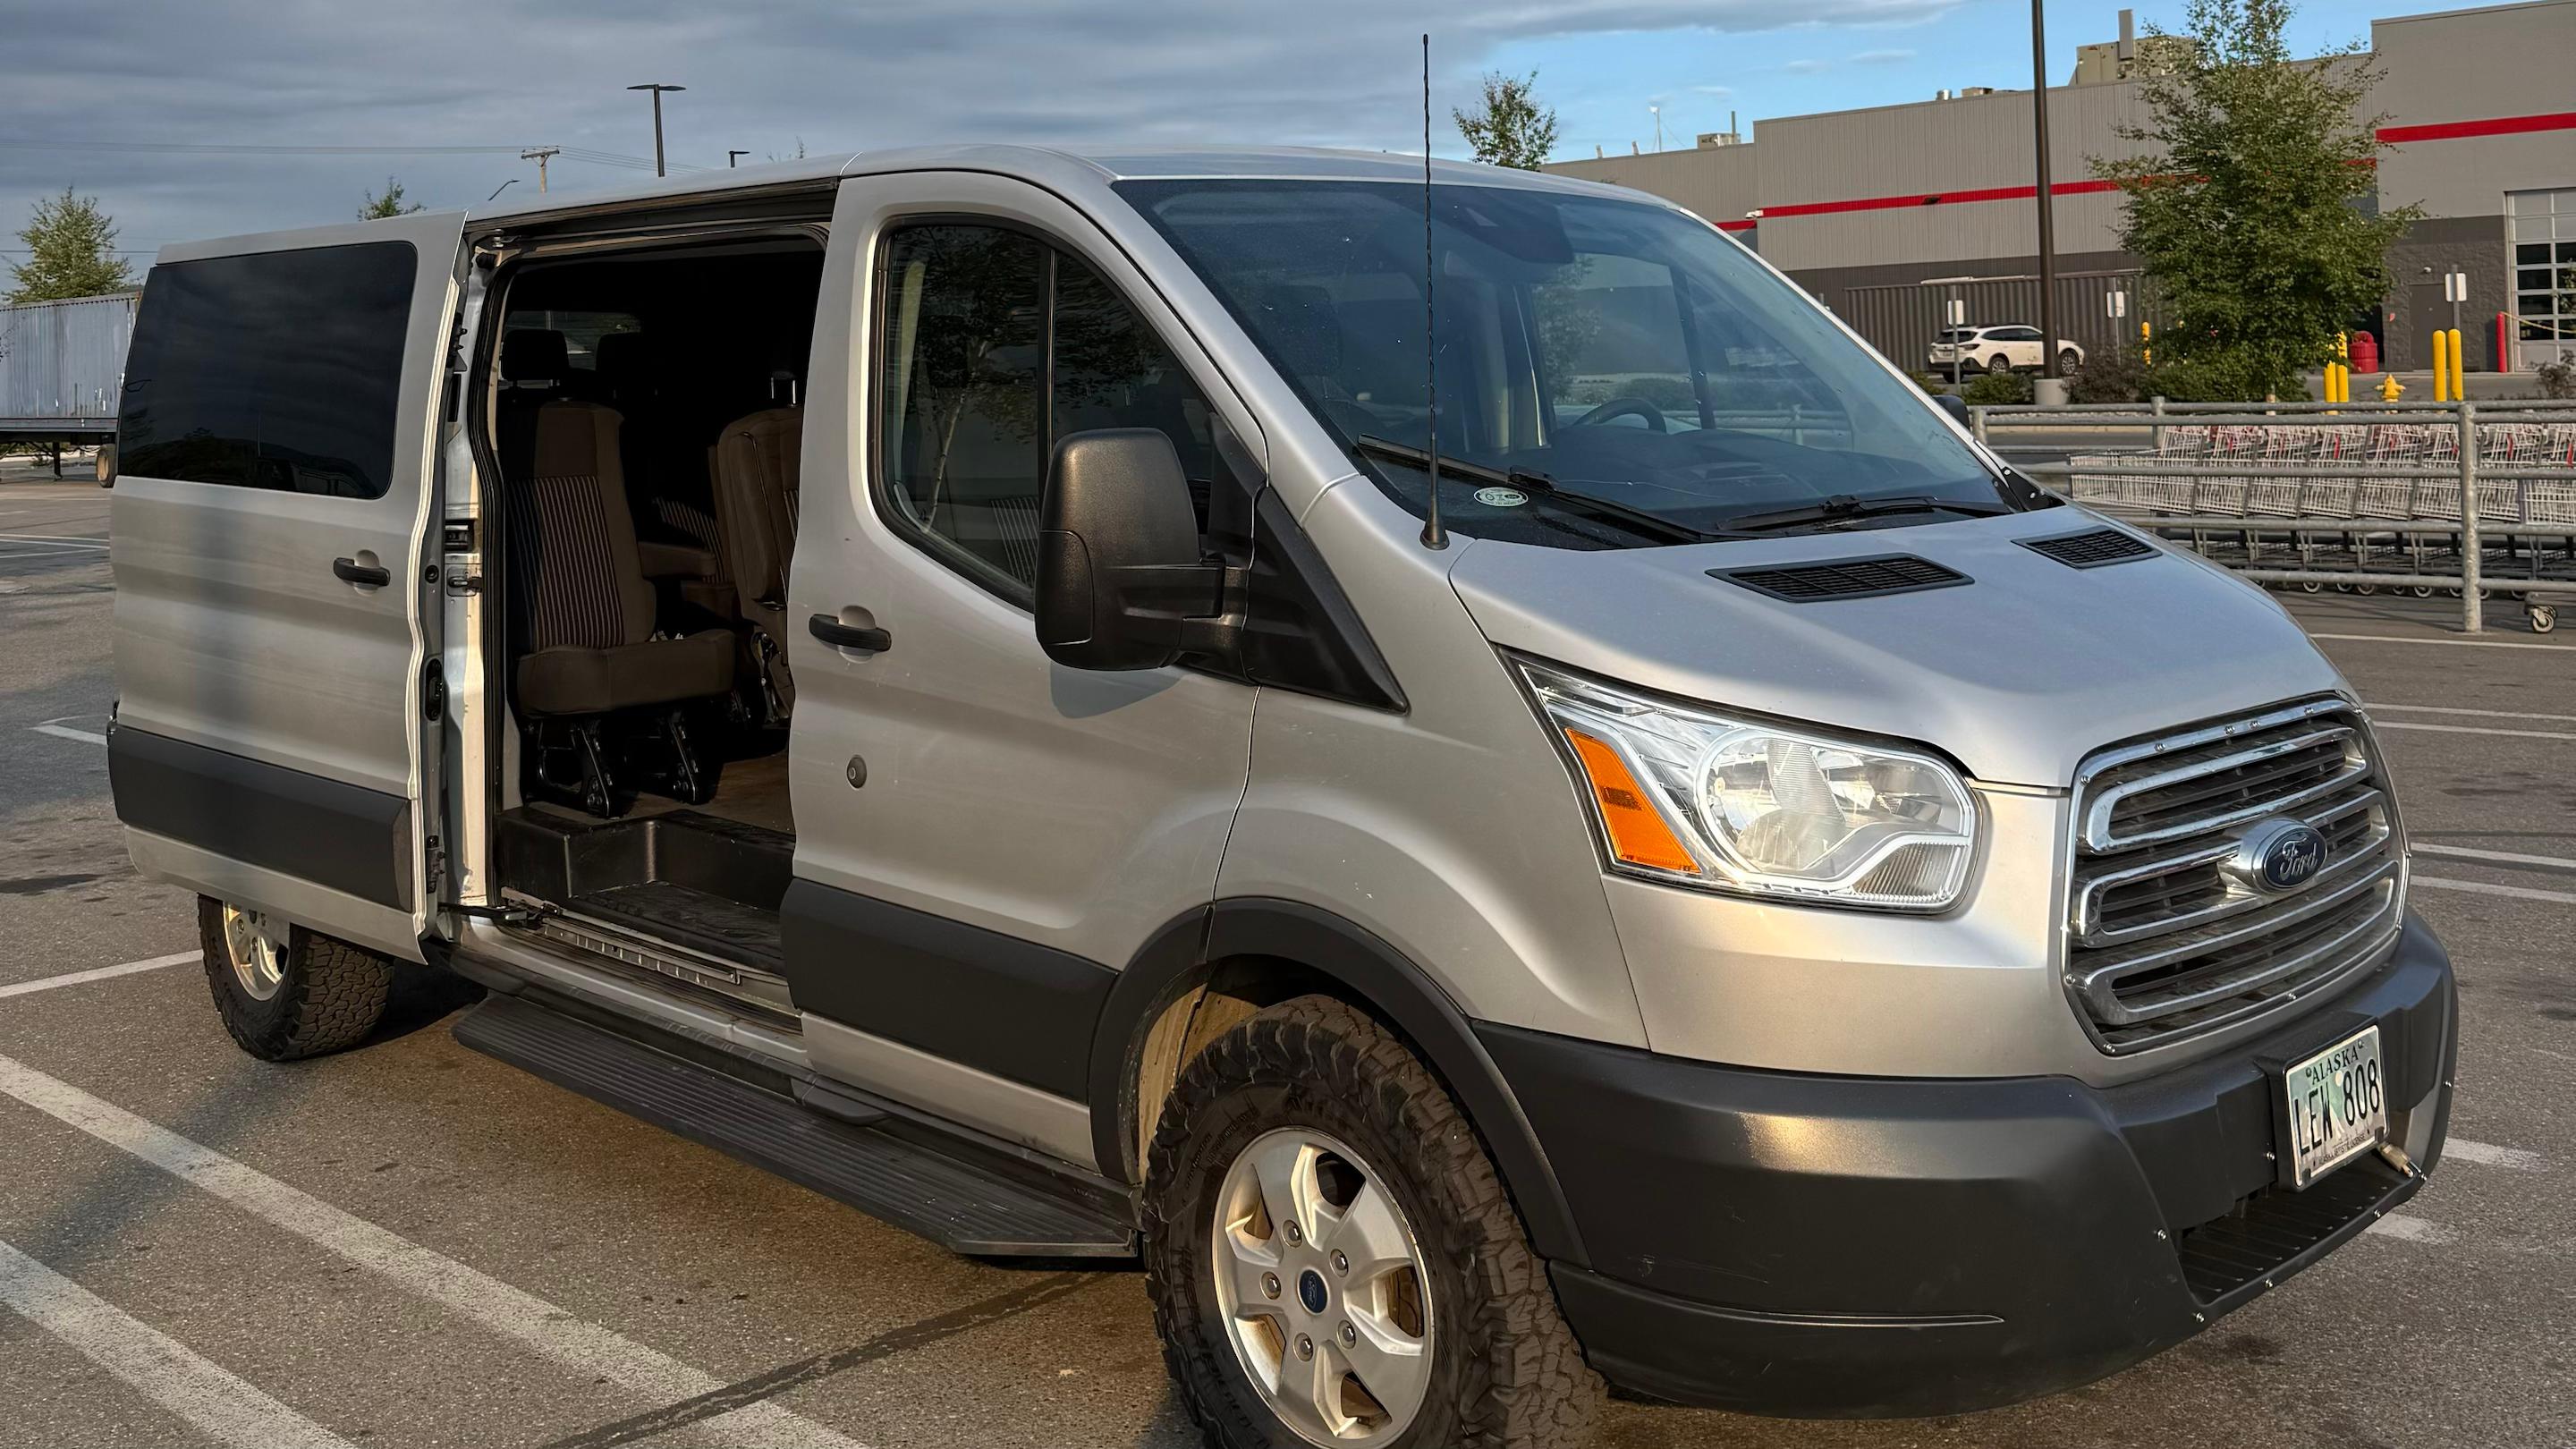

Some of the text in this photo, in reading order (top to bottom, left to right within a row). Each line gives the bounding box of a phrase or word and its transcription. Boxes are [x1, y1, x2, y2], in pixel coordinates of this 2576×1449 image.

[2278, 836, 2318, 881] Ford
[2311, 1046, 2359, 1086] ALASKA
[2293, 1058, 2380, 1157] LEW 808
